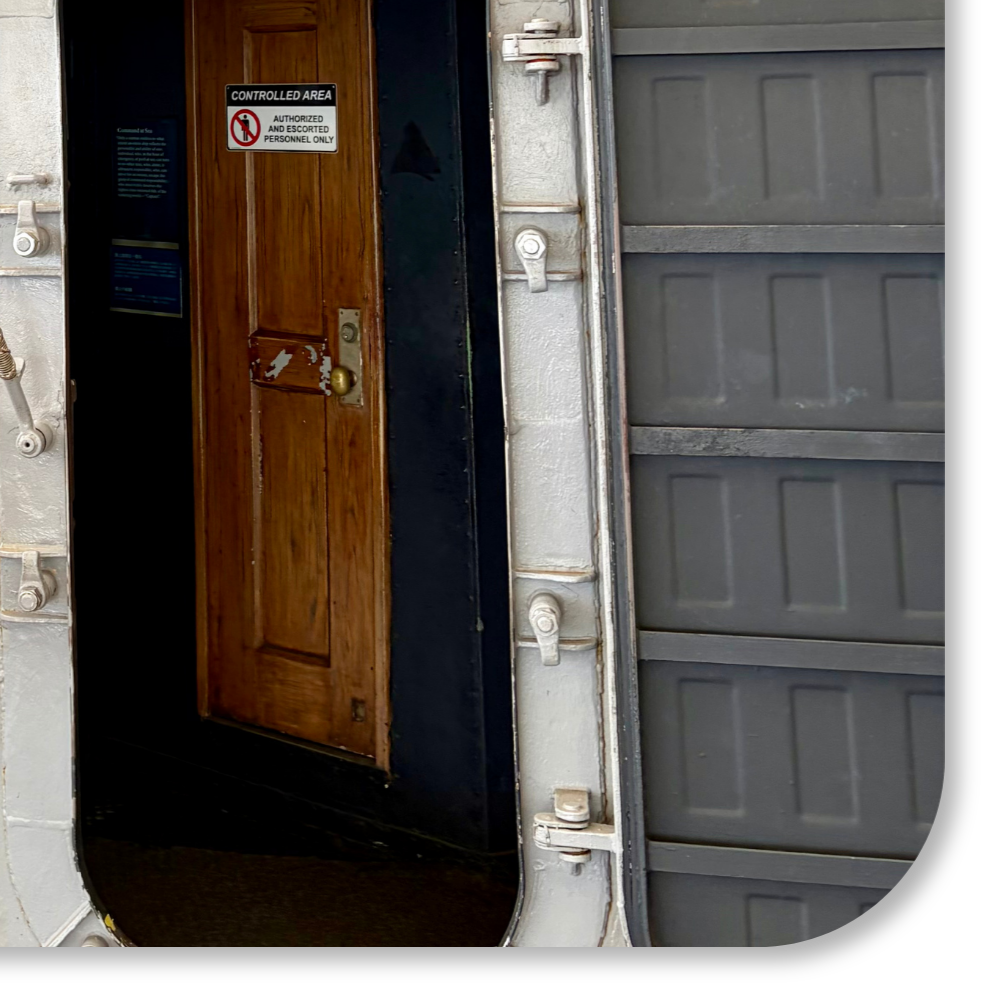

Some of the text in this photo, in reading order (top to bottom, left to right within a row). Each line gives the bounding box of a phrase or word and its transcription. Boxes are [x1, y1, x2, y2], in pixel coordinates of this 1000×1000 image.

[231, 90, 332, 101] CONTROLLED AREA
[264, 135, 311, 143] PERSONNEL
